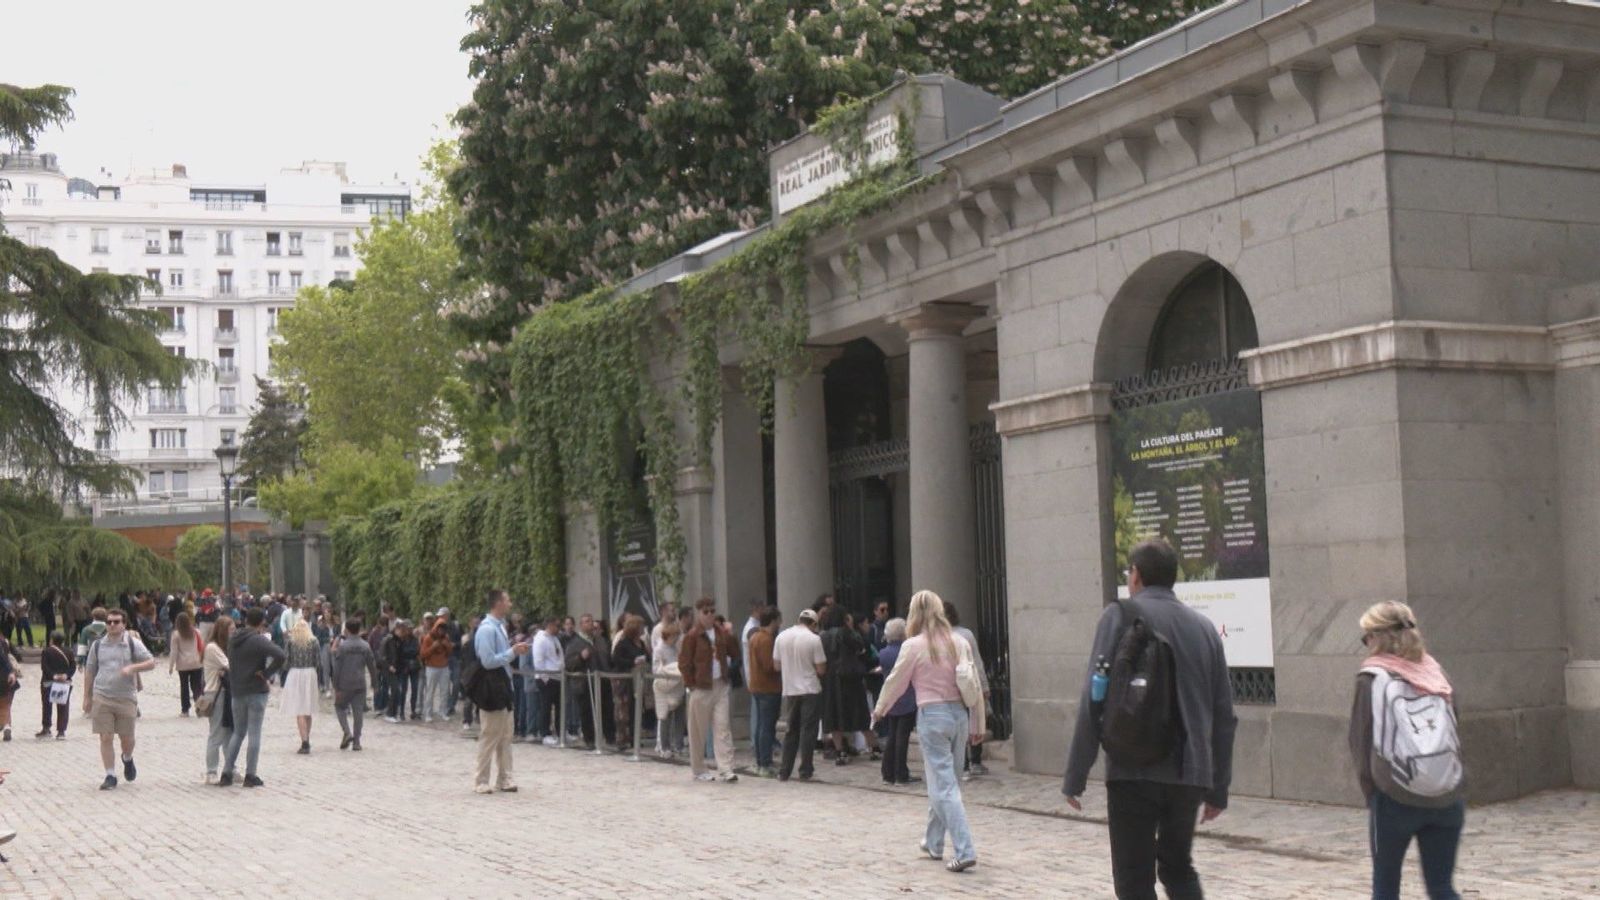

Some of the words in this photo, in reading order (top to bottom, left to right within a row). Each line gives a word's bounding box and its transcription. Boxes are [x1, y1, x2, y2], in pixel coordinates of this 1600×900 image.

[780, 173, 803, 195] REAL
[1141, 440, 1150, 448] LA
[1151, 434, 1180, 447] CULTURA
[1181, 432, 1194, 442] DEL
[1195, 426, 1223, 439] PAISAJE
[1131, 452, 1140, 461] LA
[1175, 445, 1184, 454] EL
[1209, 440, 1215, 449] Y
[1215, 439, 1223, 448] EL
